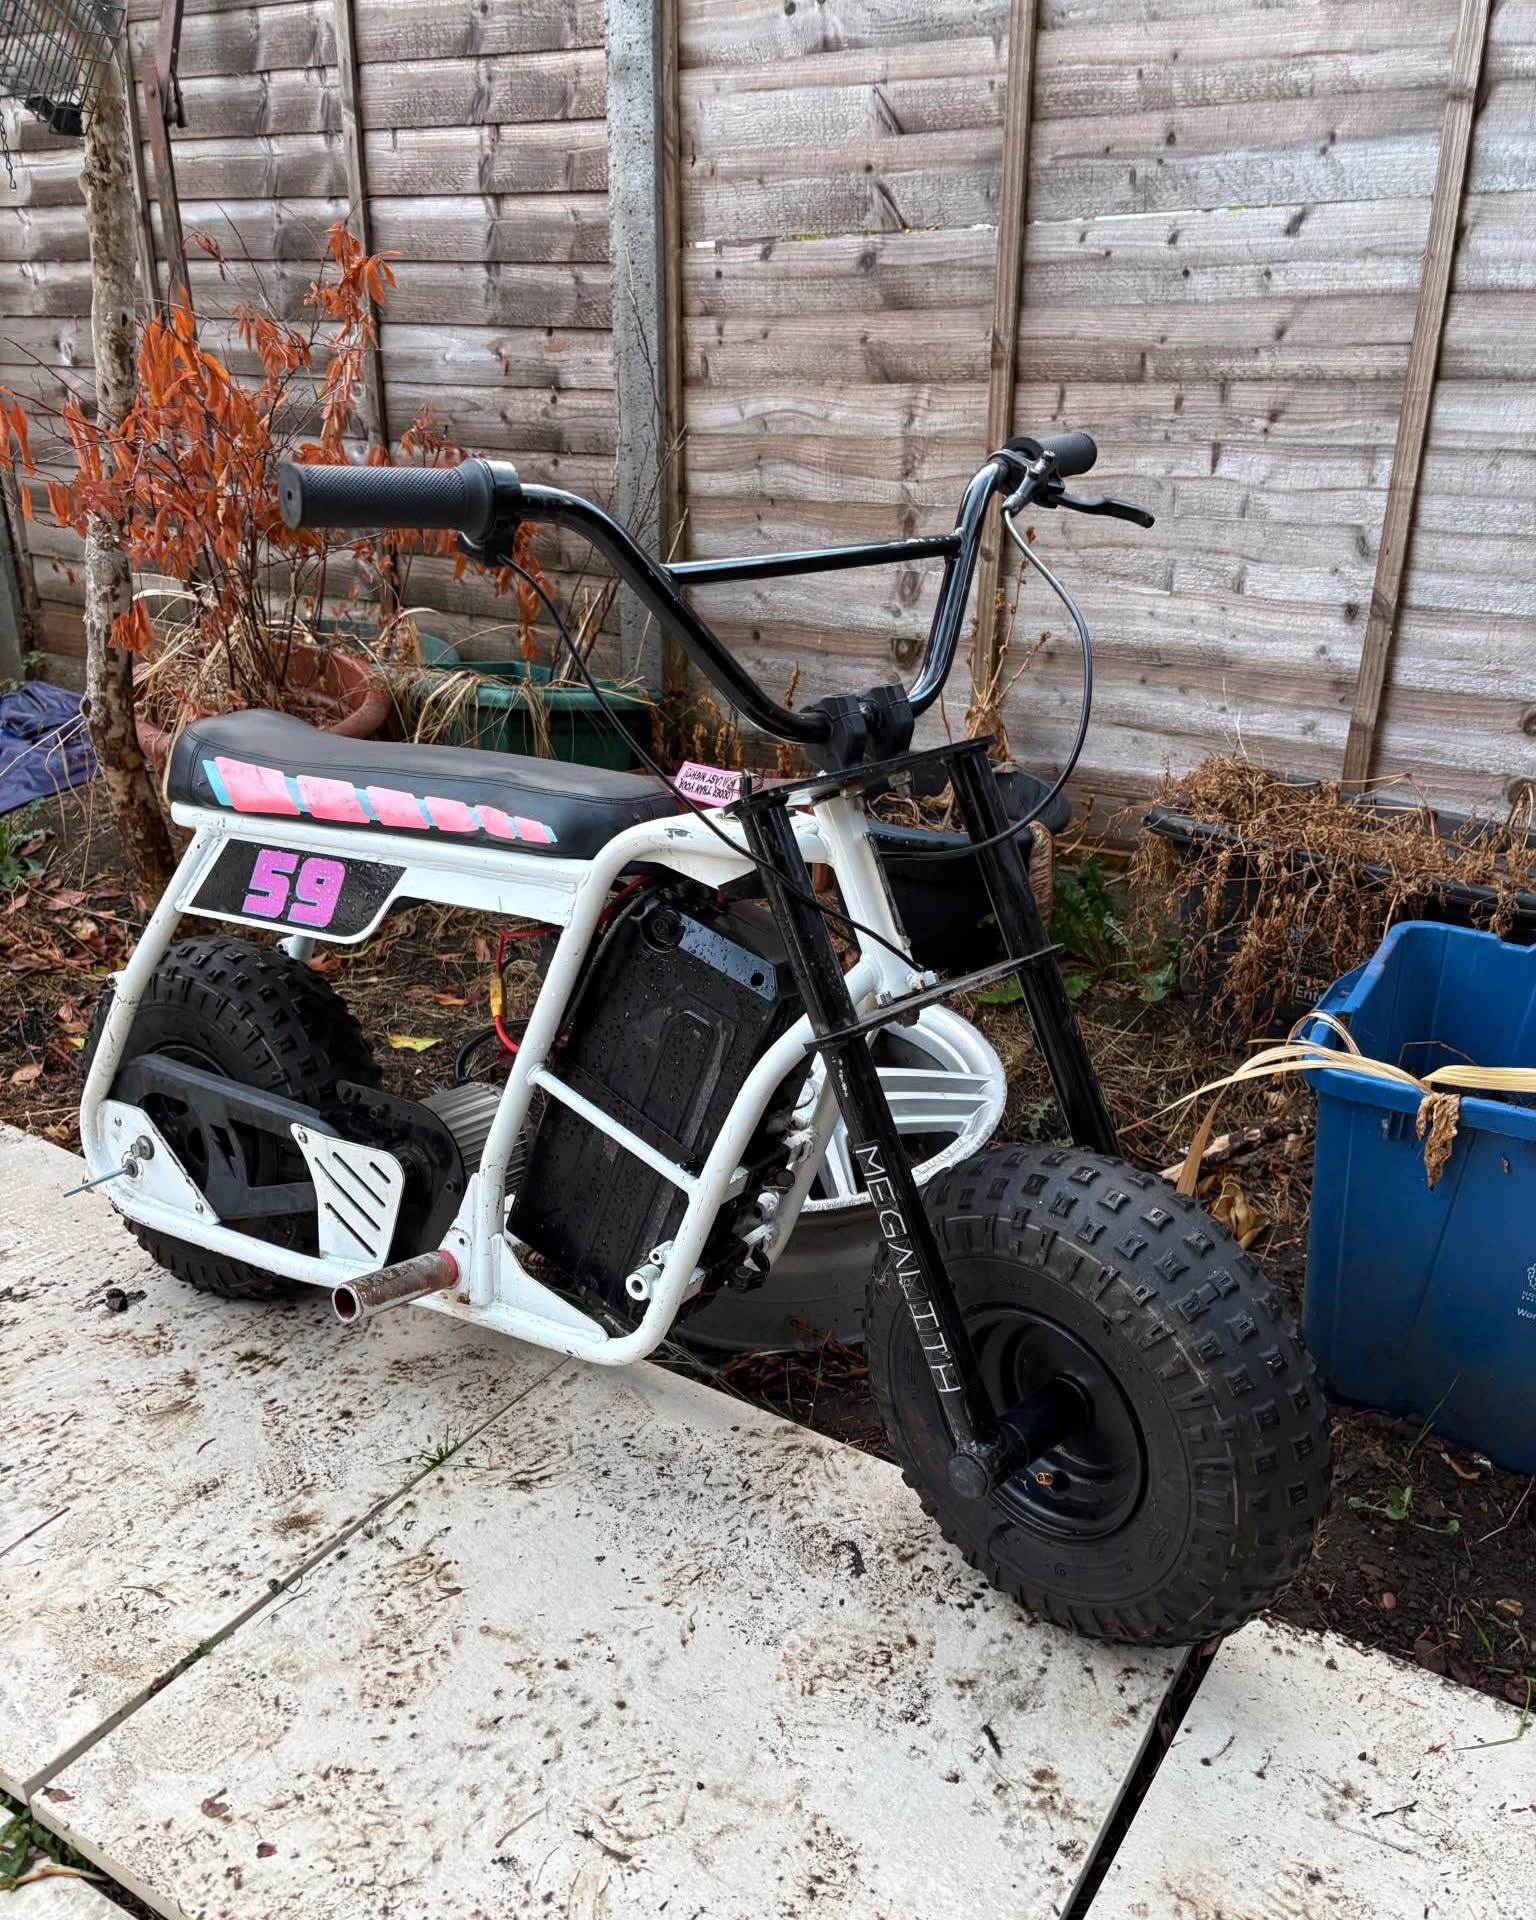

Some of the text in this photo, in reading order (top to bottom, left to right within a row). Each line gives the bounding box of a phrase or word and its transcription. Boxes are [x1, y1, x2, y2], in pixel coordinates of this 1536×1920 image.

[706, 774, 723, 786] LAST
[696, 783, 711, 796] THAN
[241, 849, 346, 928] 59
